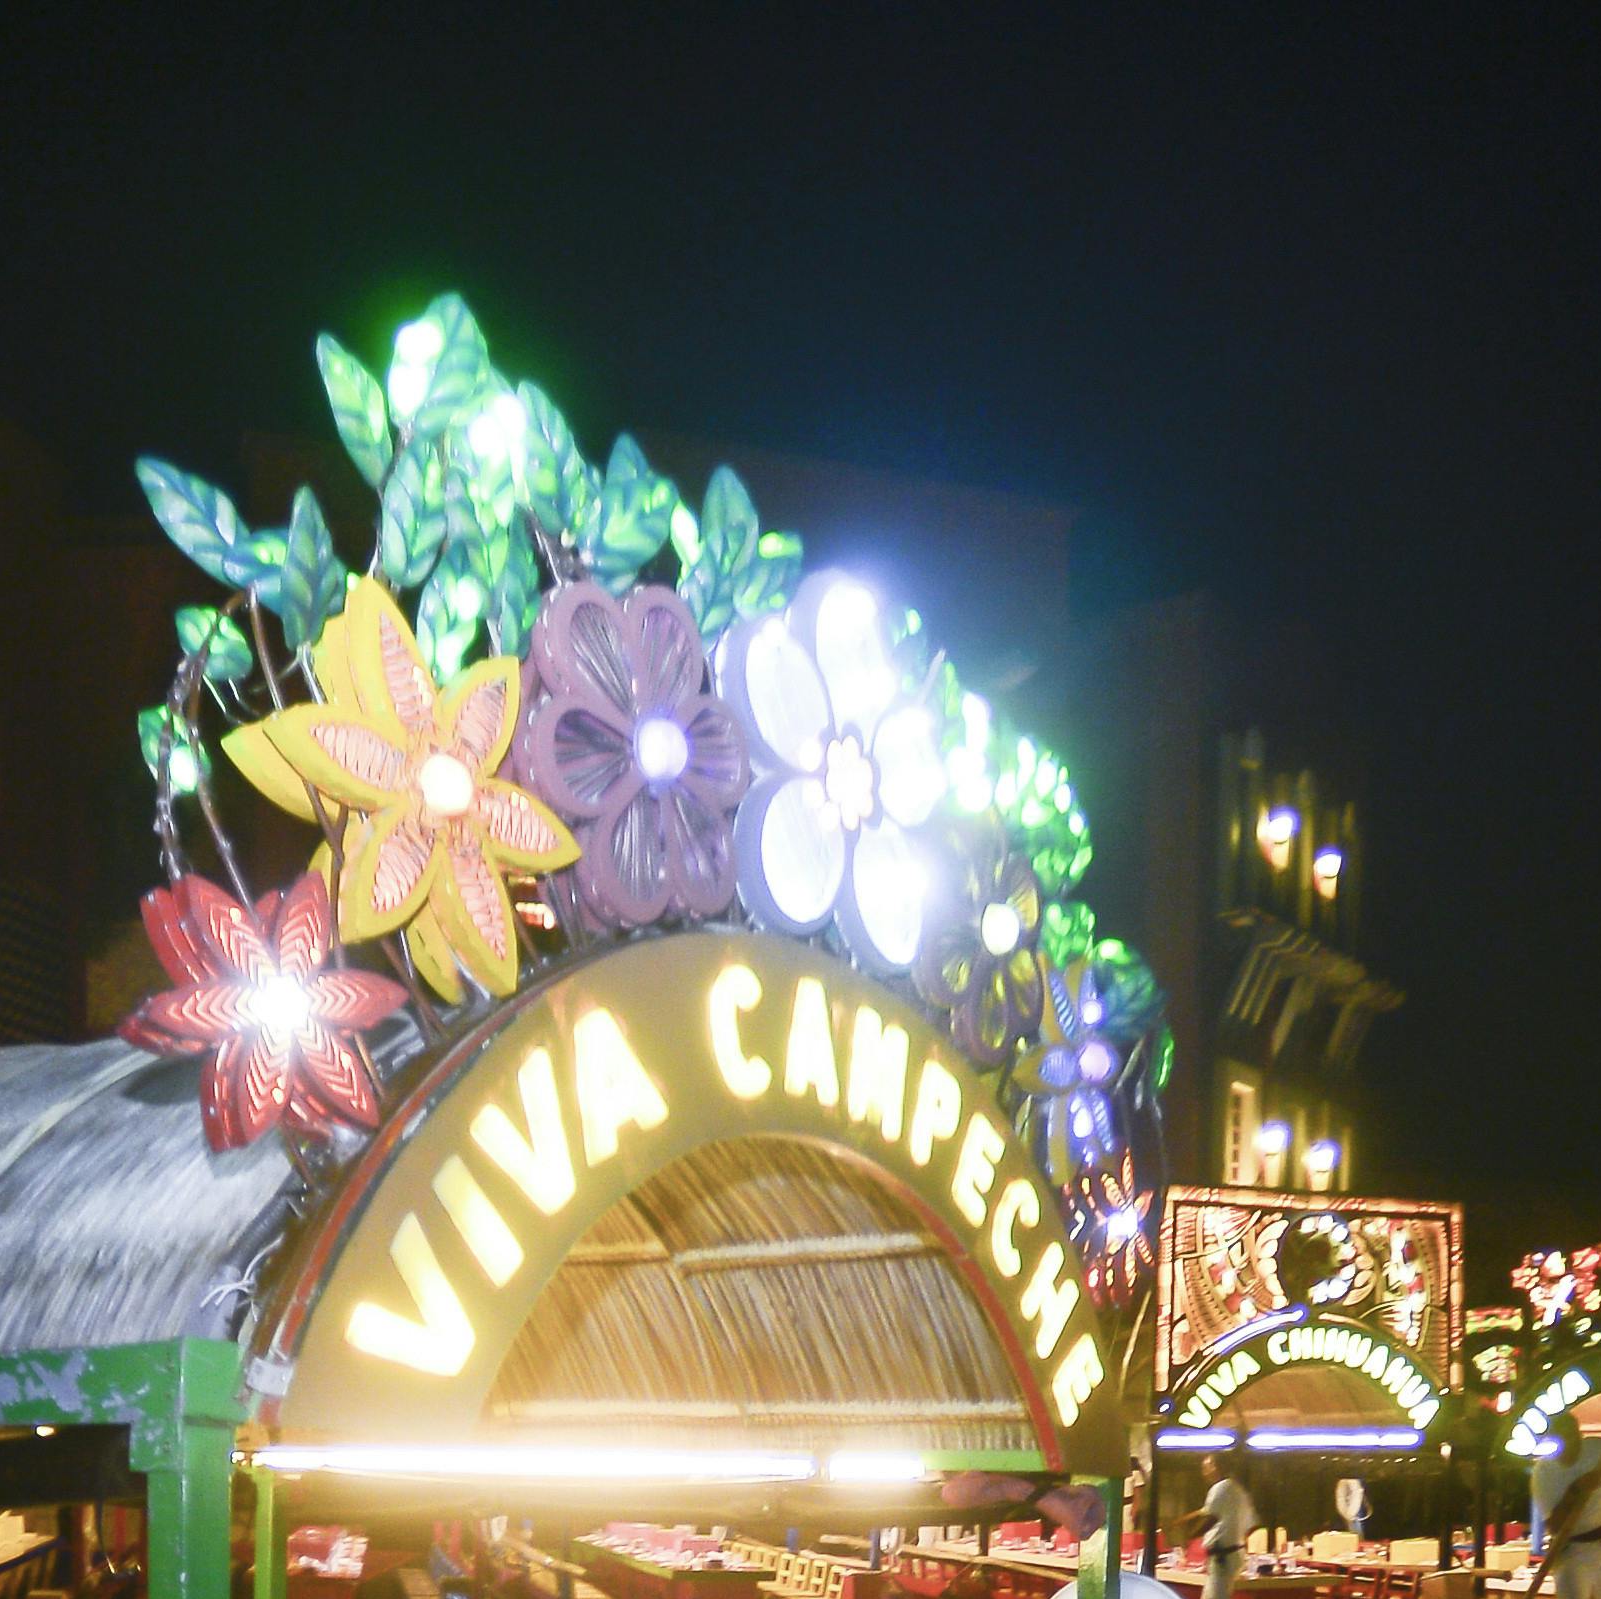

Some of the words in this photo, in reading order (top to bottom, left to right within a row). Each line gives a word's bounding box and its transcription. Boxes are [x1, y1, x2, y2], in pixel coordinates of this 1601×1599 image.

[344, 1003, 669, 1377] VIVA
[705, 961, 1106, 1428] CAMPECHE
[1178, 1350, 1262, 1429] VIVA
[1266, 1326, 1441, 1430] CHIHUAHUA
